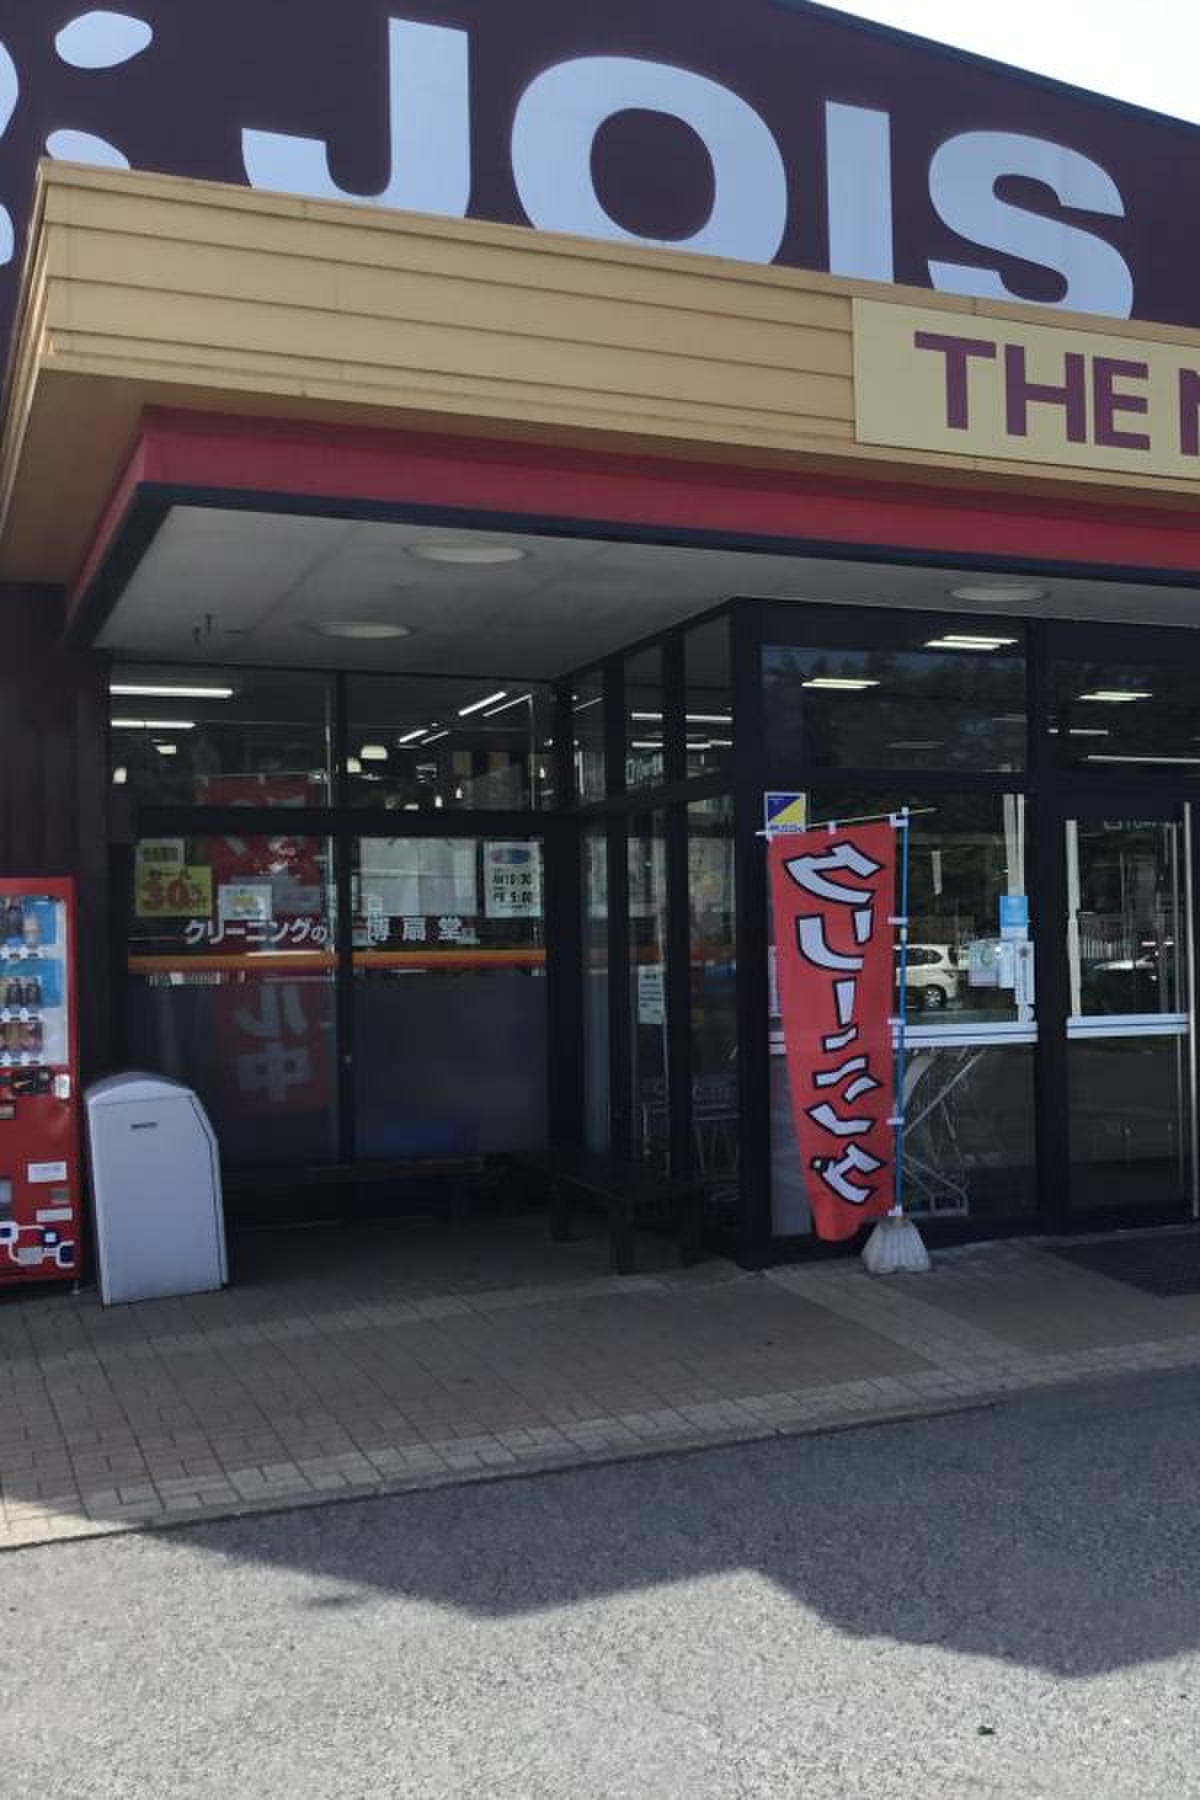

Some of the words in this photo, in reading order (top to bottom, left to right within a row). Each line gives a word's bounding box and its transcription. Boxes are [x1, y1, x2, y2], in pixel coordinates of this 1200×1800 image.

[241, 17, 1134, 320] JOIS
[914, 330, 1151, 452] THE
[184, 918, 329, 944] クリーニングの
